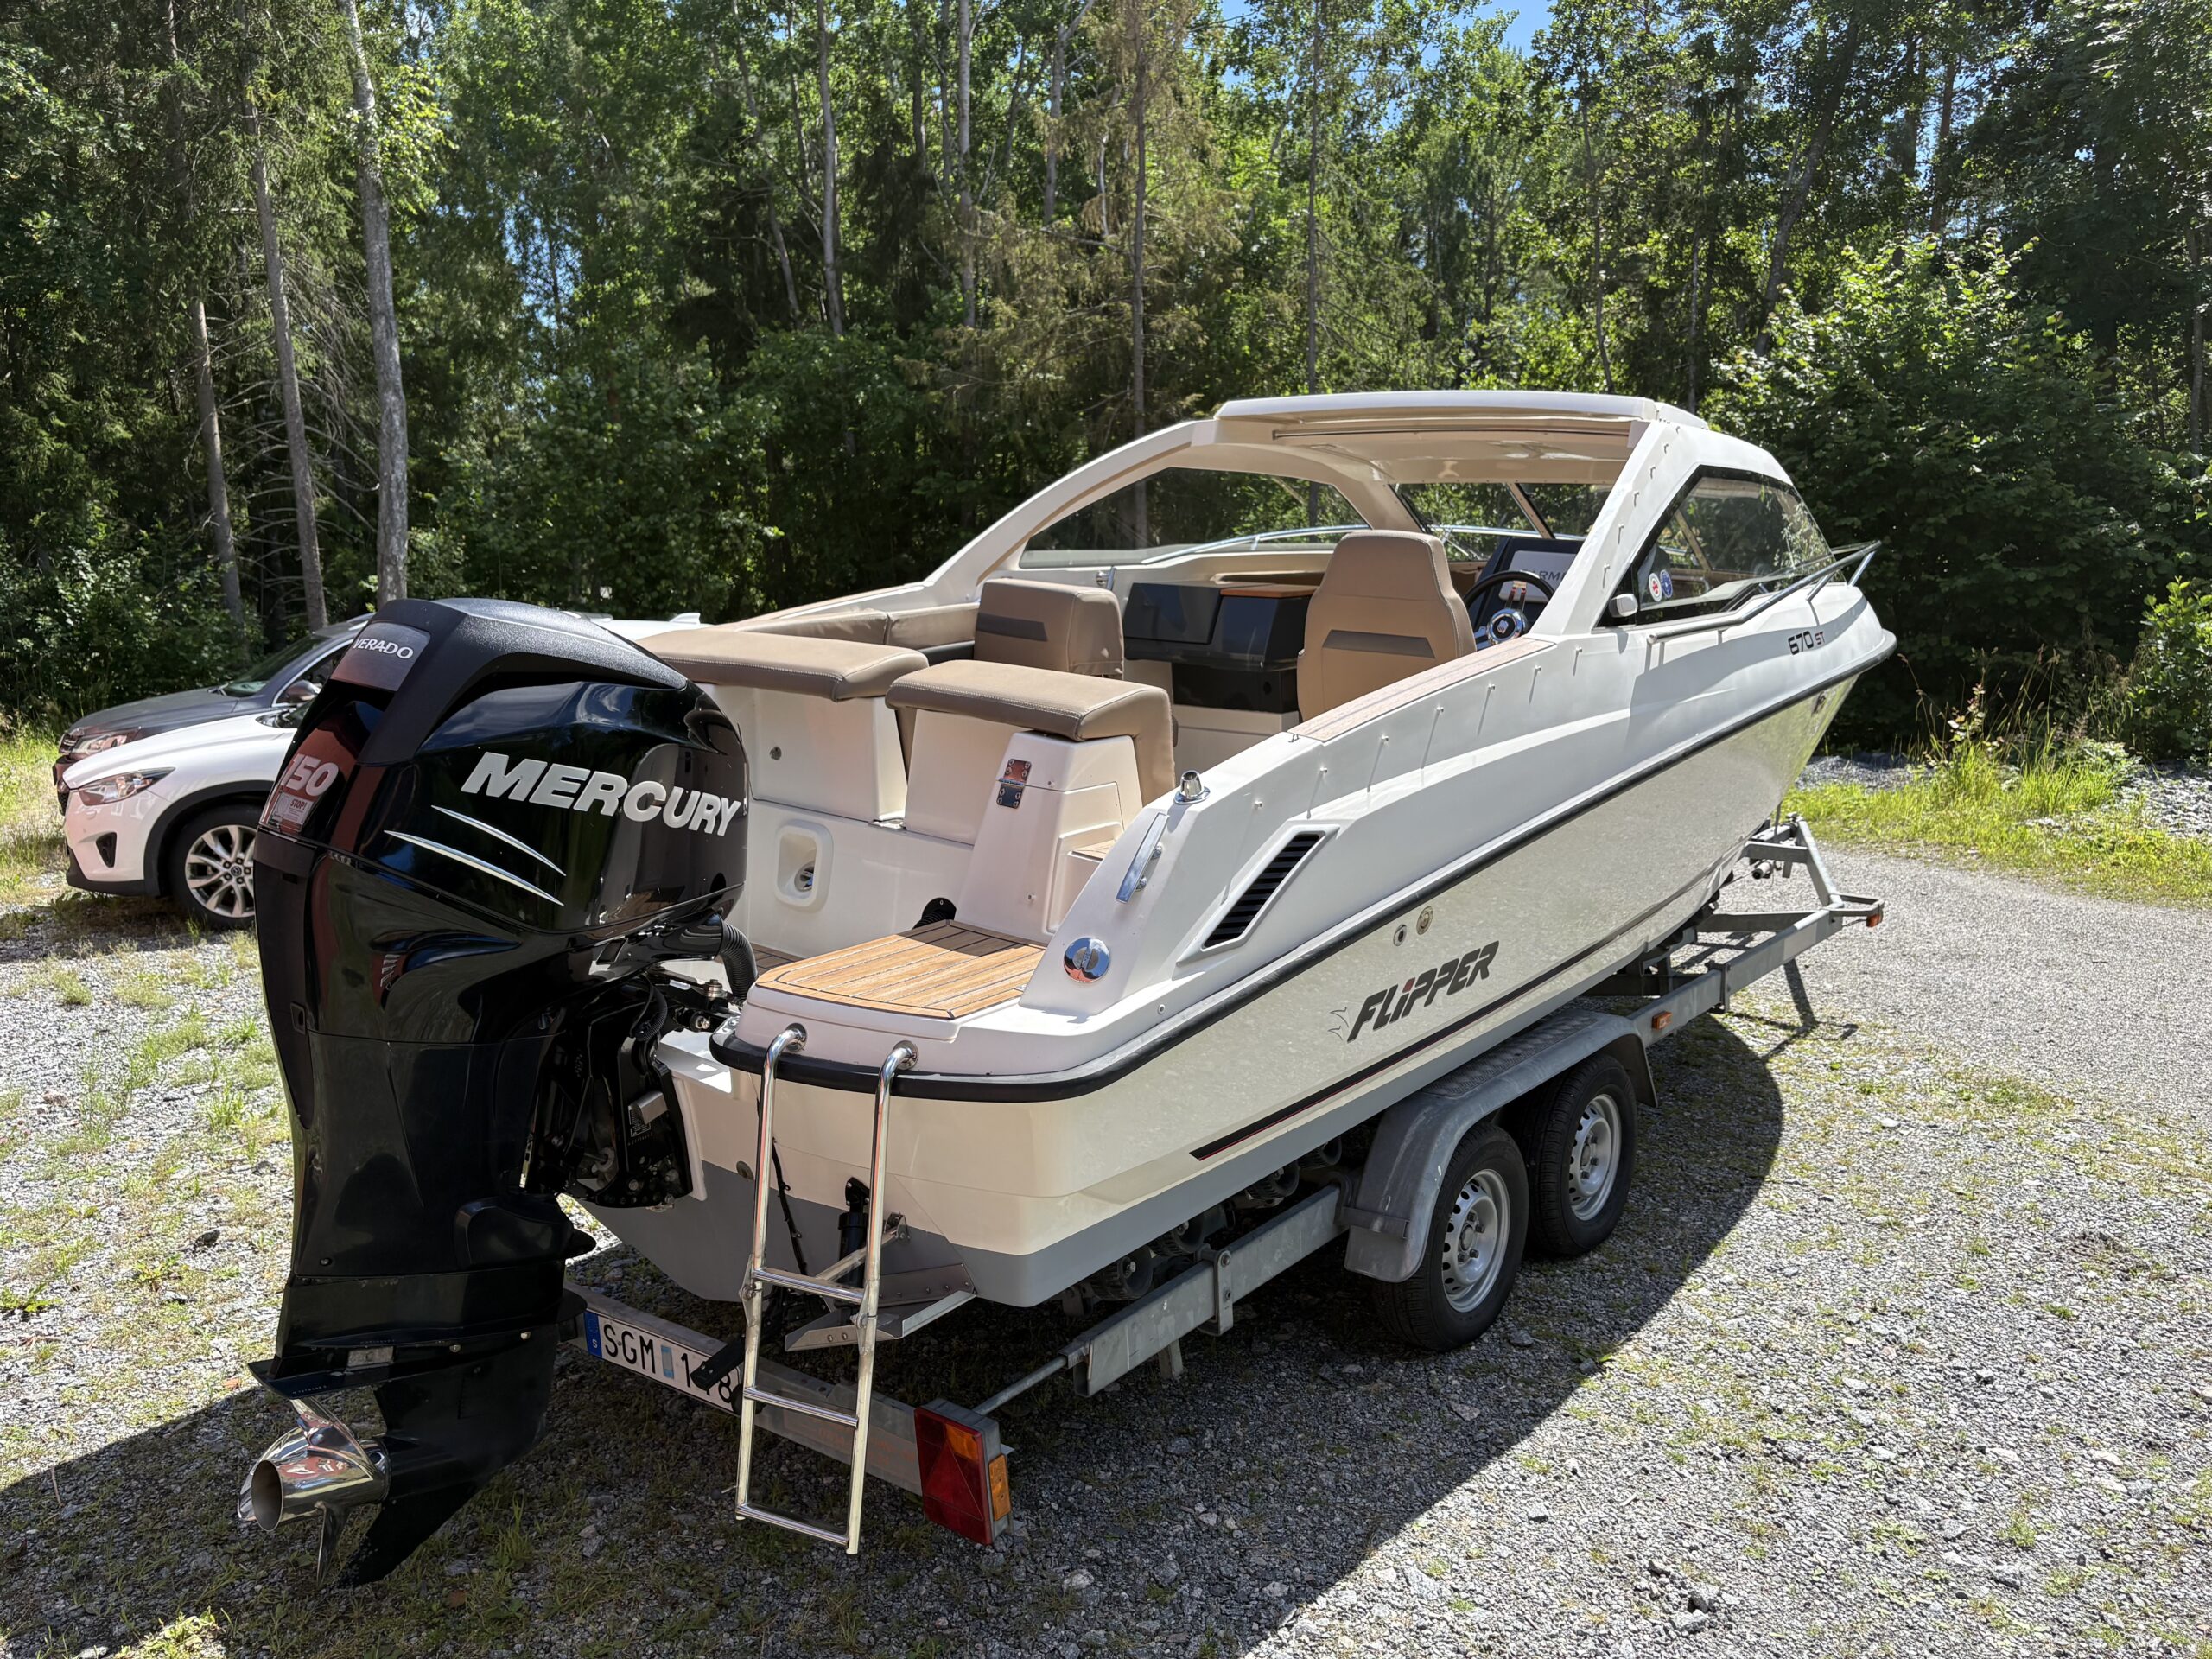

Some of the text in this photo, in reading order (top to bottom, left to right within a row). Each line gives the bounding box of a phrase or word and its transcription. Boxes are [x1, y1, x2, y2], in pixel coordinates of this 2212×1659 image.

[353, 638, 414, 659] VERADO
[1788, 631, 1825, 655] 670 ST
[280, 753, 339, 796] 150
[461, 752, 741, 836] MERCURY
[592, 1338, 598, 1348] S
[603, 1324, 733, 1403] SGM 18
